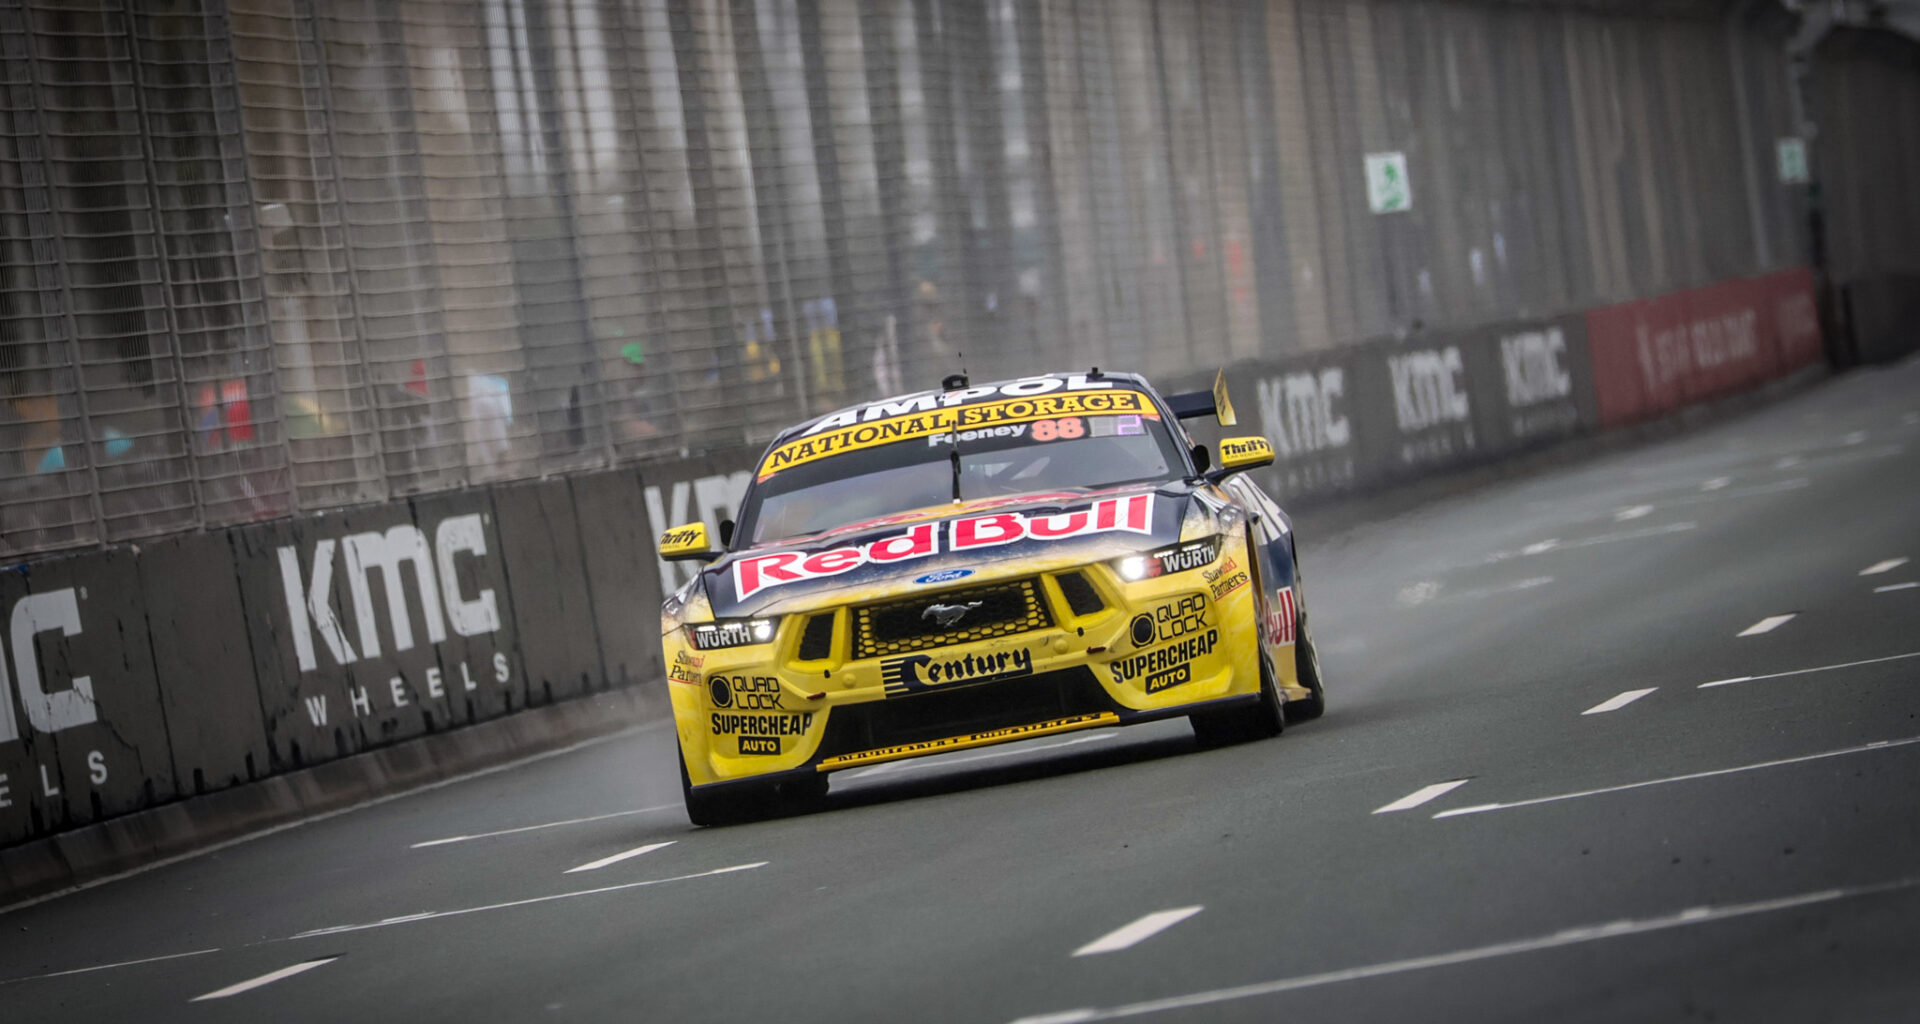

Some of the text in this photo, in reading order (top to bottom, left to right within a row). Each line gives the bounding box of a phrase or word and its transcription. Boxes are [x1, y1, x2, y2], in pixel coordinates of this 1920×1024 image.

[801, 376, 1112, 438] AMPOL
[770, 394, 1135, 469] NATIONAL STORAGE
[928, 416, 1085, 448] Feeney 88
[1222, 439, 1271, 456] Thrifty
[733, 524, 939, 602] Red
[949, 493, 1156, 552] Bull
[1163, 545, 1216, 573] WÜRTH
[1156, 593, 1206, 623] QUAD
[695, 628, 751, 649] WÜRTH
[1158, 610, 1208, 641] LOCK
[1110, 629, 1217, 683] SUPERCHEAP
[732, 675, 780, 693] QUAD
[881, 647, 1033, 698] Century
[1150, 668, 1186, 691] AUTO
[304, 652, 509, 727] WHEELS
[735, 693, 785, 710] LOCK
[711, 712, 813, 736] SUPERCHEAP
[742, 740, 777, 752] AUTO
